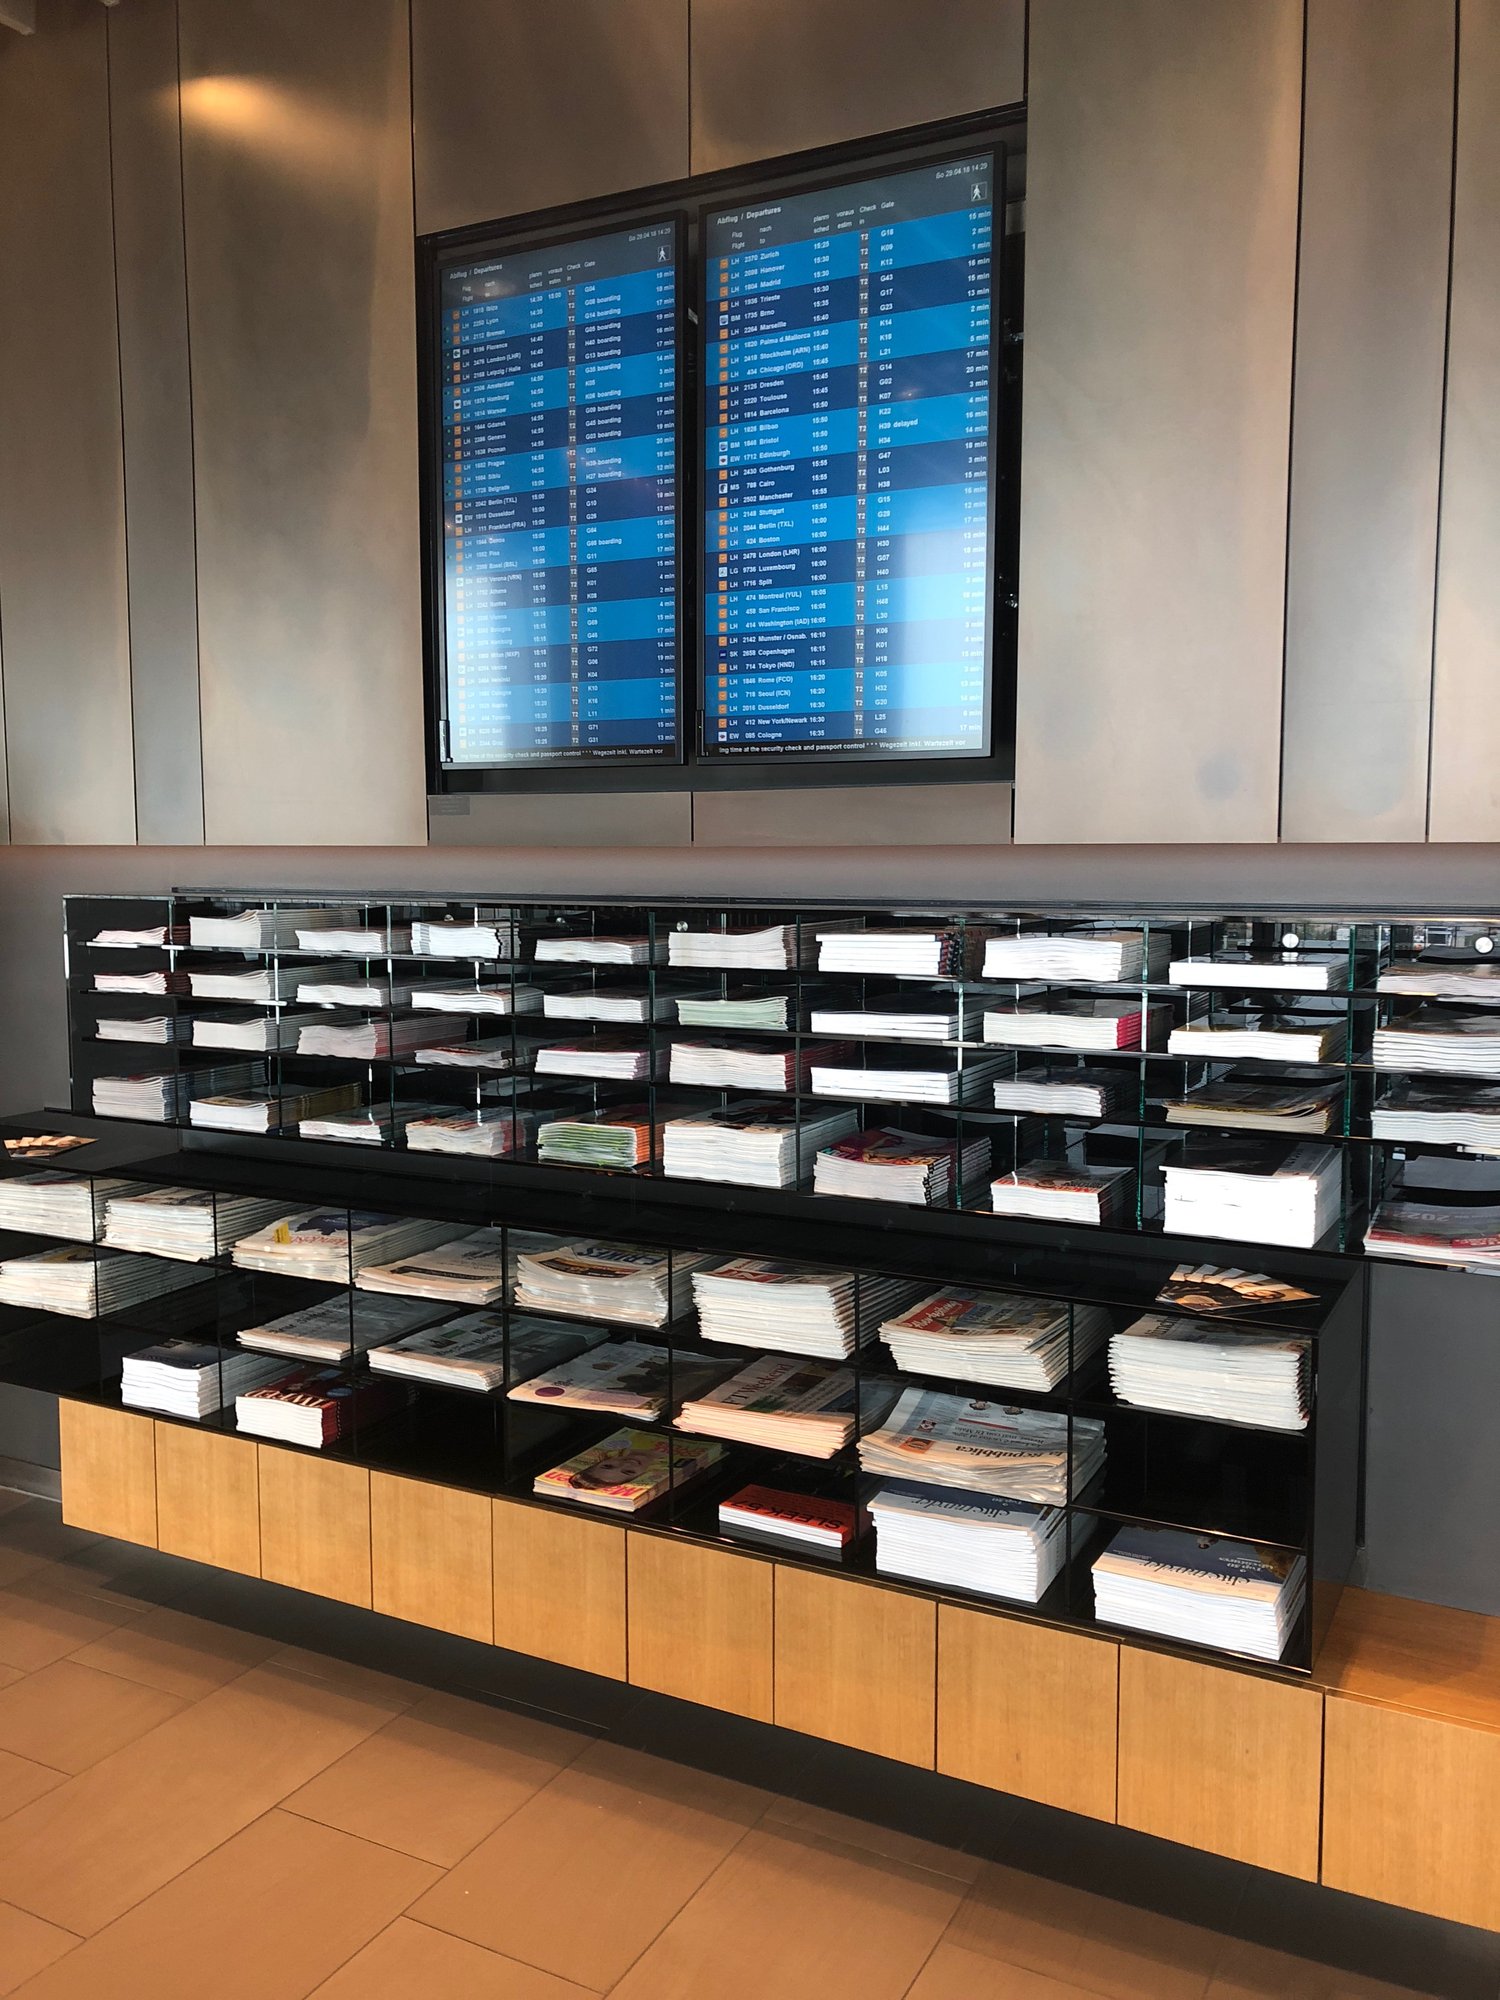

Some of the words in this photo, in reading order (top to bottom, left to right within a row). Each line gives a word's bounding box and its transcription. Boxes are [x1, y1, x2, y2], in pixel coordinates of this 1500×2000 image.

[859, 204, 876, 213] Check
[881, 200, 894, 209] Gate
[718, 213, 737, 225] Abflug
[746, 205, 781, 220] Departures
[760, 250, 779, 259] Zurich
[813, 240, 829, 249] 15:25
[474, 262, 502, 276] Departures
[760, 263, 784, 274] Hanover
[813, 255, 829, 263] 15:30
[760, 278, 780, 288] Madrid
[813, 269, 829, 278] 15:30
[760, 293, 780, 302] Trieste
[813, 284, 829, 293] 15:30
[597, 294, 620, 305] boarding
[760, 308, 774, 317] Brno
[813, 299, 828, 307] 15:35
[597, 321, 620, 332] boarding
[760, 320, 786, 330] Marseille
[813, 313, 828, 321] 15:40
[597, 335, 620, 345] boarding
[760, 336, 777, 345] Palma
[779, 331, 810, 343] d.Mallorca
[813, 328, 828, 337] 15:40
[760, 348, 791, 359] Stockholm
[812, 342, 828, 351] 15:40
[760, 364, 783, 375] Chicago
[812, 357, 828, 365] 15:45
[760, 378, 783, 388] Dresden
[812, 372, 828, 380] 15:45
[760, 392, 786, 402] Toulouse
[812, 387, 828, 395] 15:45
[597, 402, 621, 413] boarding
[759, 406, 788, 416] Barcelona
[812, 401, 827, 409] 15:50
[597, 416, 621, 426] boarding
[759, 422, 778, 431] Bilbao
[812, 416, 827, 424] 15:50
[759, 436, 778, 444] Bristol
[812, 430, 827, 438] 15:50
[893, 418, 917, 428] delayed
[759, 449, 790, 459] Edinburgh
[812, 444, 827, 452] 15:50
[759, 463, 794, 474] Gothenburg
[812, 459, 827, 467] 15:55
[759, 479, 774, 487] Cairo
[811, 473, 827, 481] 15:55
[759, 491, 792, 501] Manchester
[759, 507, 784, 517] Stuttgart
[598, 537, 621, 546] boarding
[759, 535, 779, 543] Boston
[759, 550, 781, 558] London
[759, 562, 795, 572] Luxembourg
[759, 578, 772, 586] Split
[759, 592, 783, 600] Montreal
[771, 604, 799, 612] Francisco
[758, 619, 792, 628] Washington
[758, 634, 781, 642] Munster
[787, 632, 806, 640] Osnab.
[758, 647, 794, 656] Copenhagen
[758, 662, 775, 670] Tokyo
[771, 716, 807, 725] York/Newark
[758, 731, 781, 739] Cologne
[540, 750, 561, 758] passport
[761, 745, 783, 753] security
[816, 743, 841, 751] passport
[731, 1500, 764, 1513] 57
[769, 1506, 843, 1530] SLEEK
